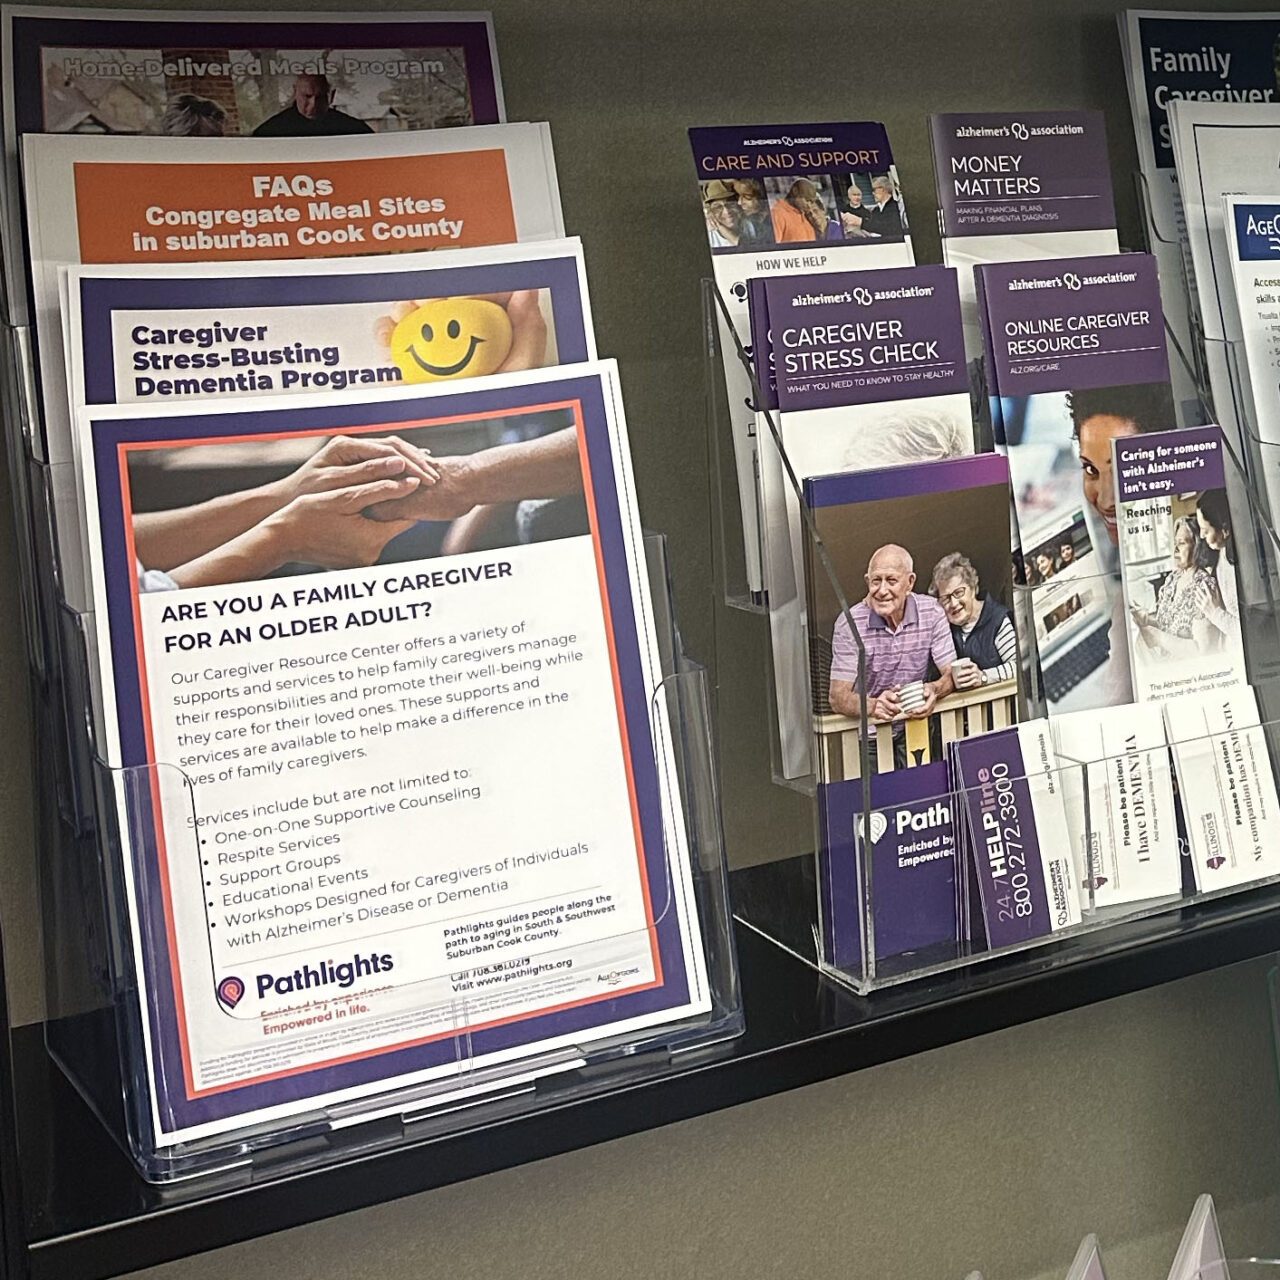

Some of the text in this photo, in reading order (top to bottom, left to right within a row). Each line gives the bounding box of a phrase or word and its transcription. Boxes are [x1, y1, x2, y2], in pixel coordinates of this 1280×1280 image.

[64, 57, 445, 79] Home-Delivered Meals Program
[1150, 46, 1231, 78] Family
[702, 150, 879, 172] CARE AND SUPPORT
[951, 156, 1022, 173] MONEY
[253, 176, 333, 198] FAQs
[954, 176, 1041, 195] MATTERS
[146, 195, 446, 228] Congregate Meal Sites
[133, 218, 464, 251] in suburban Cook County
[791, 289, 852, 307] alzheimer's
[132, 323, 268, 347] Caregiver
[782, 321, 902, 347] CAREGIVER
[1005, 311, 1150, 337] ONLINE CAREGIVER
[133, 344, 340, 372] Stress-Busting
[784, 341, 939, 372] STRESS CHECK
[1007, 334, 1100, 355] RESOURCES
[135, 365, 402, 397] Dementia Program
[1121, 439, 1217, 462] Caring for someone
[1122, 457, 1204, 477] with Alzheimer's
[1124, 479, 1174, 493] isn't easy.
[161, 561, 513, 623] ARE YOU A FAMILY CAREGIVER
[164, 601, 433, 653] FOR AN OLDER ADULT?
[215, 785, 481, 845] One-on-One Supportive Counseling
[217, 832, 341, 866] Respite Services
[992, 763, 1032, 917] 800.272.3900
[219, 852, 341, 887] Support Groups
[222, 868, 369, 908] Educational Events
[256, 953, 393, 999] Pathlights
[263, 1003, 370, 1036] Empowered in life.
